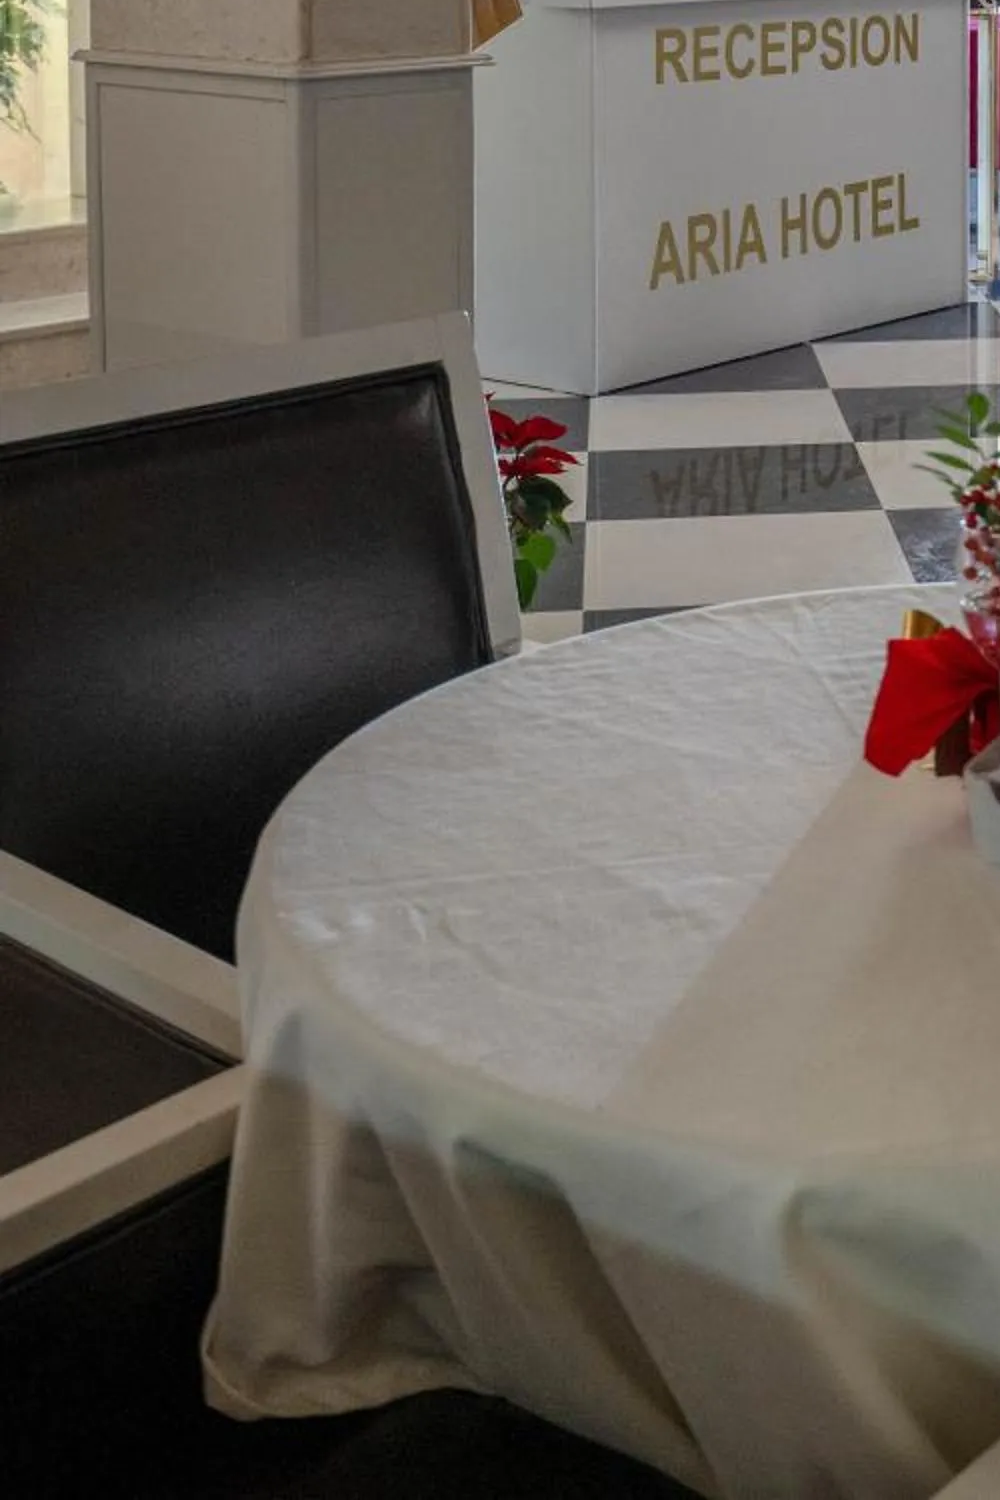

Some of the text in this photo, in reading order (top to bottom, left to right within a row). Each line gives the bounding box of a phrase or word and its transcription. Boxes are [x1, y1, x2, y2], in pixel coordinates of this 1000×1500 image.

[655, 13, 919, 84] RECEPSION
[649, 173, 920, 290] ARIA HOTEL
